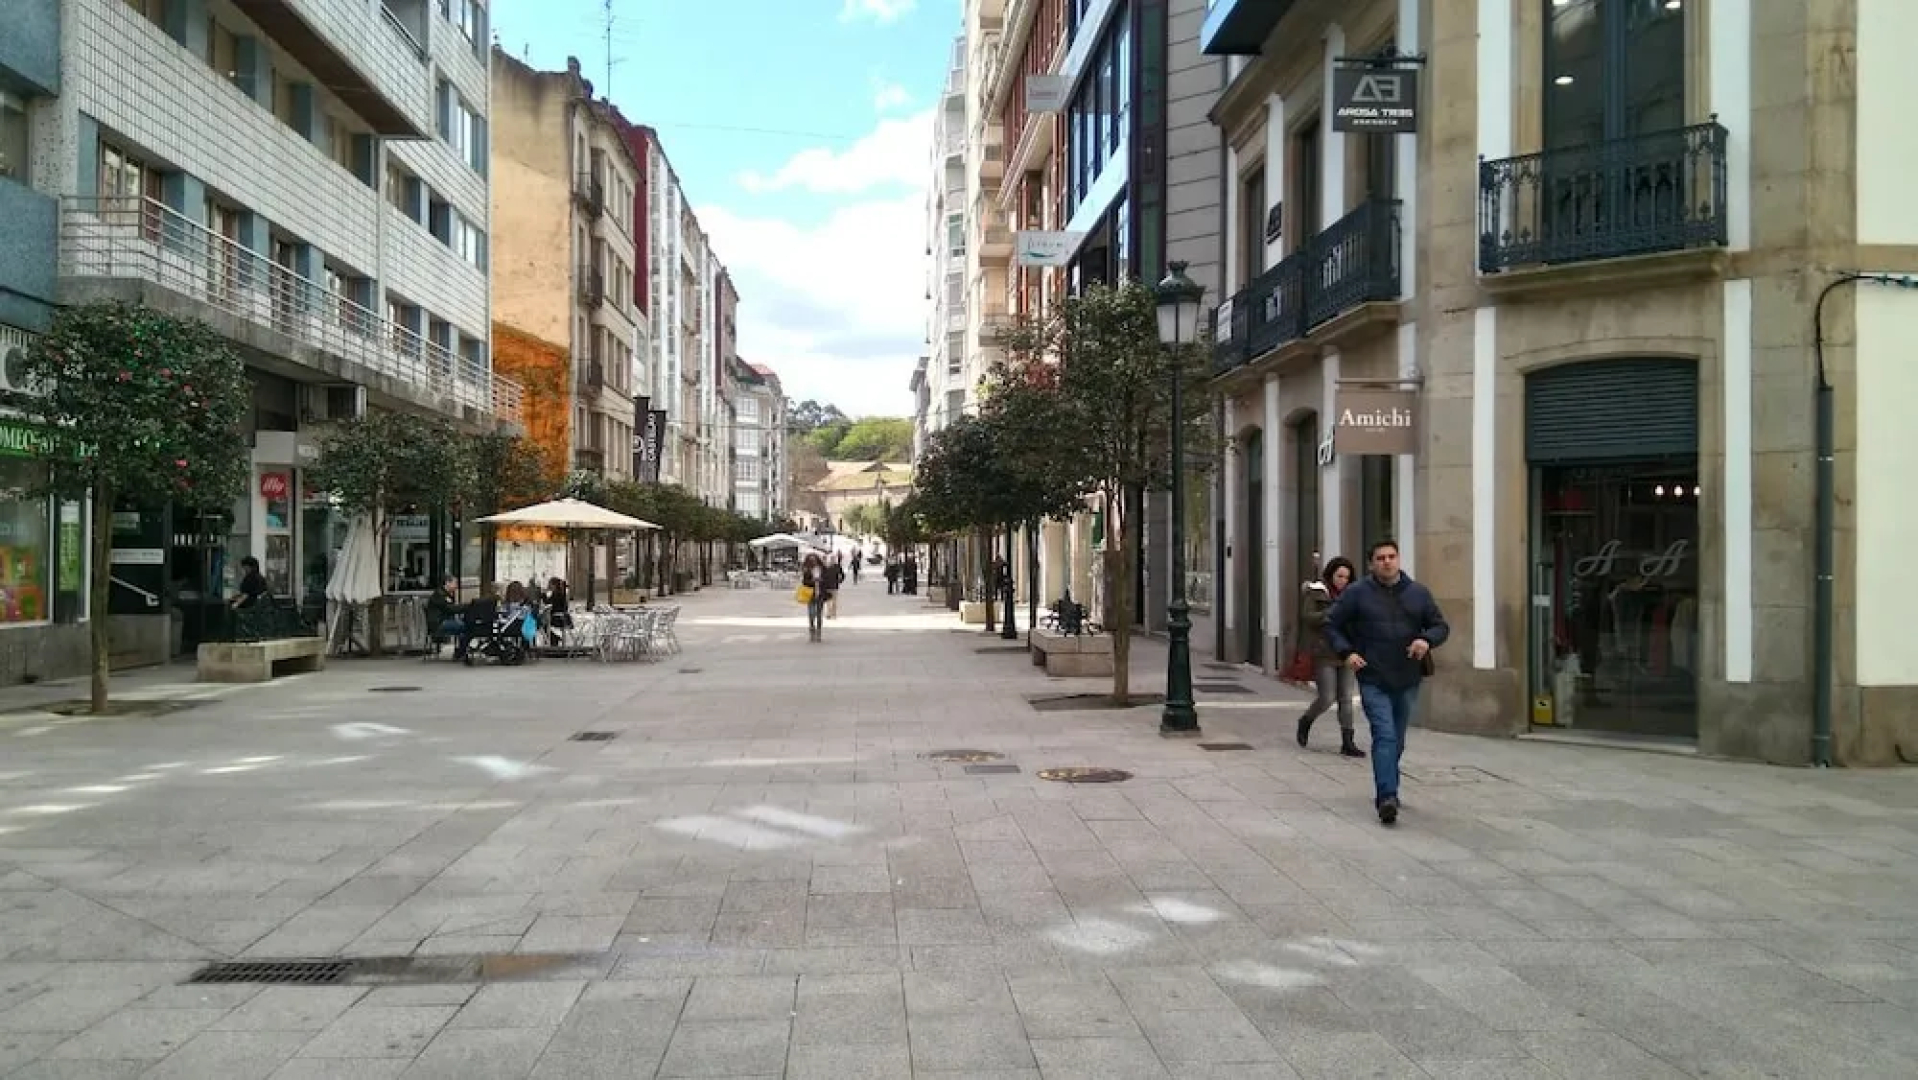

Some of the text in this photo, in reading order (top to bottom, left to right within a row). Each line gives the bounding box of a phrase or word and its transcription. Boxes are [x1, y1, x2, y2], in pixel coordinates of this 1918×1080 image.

[1337, 106, 1378, 117] AROSA
[1339, 407, 1412, 427] Amichi
[262, 476, 285, 494] illy
